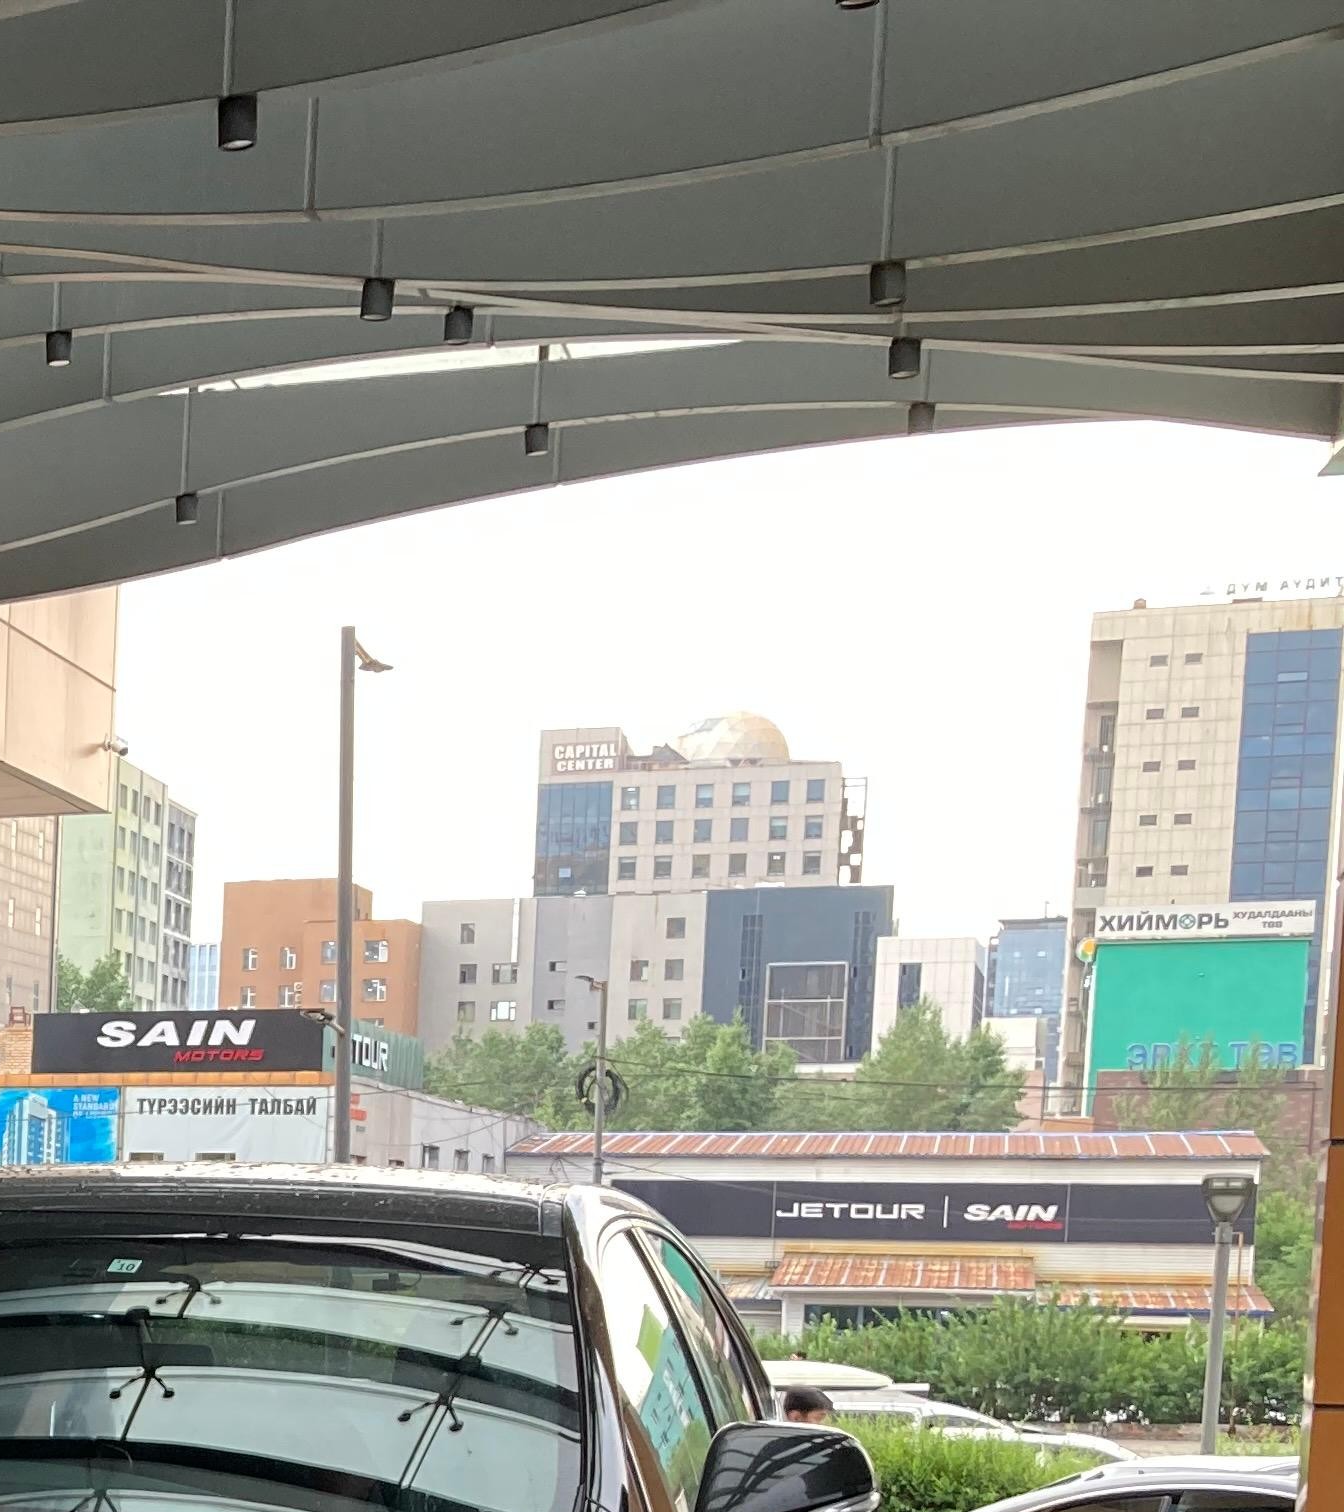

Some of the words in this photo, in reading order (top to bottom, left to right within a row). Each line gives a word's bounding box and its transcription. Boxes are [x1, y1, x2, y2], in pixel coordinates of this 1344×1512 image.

[554, 743, 617, 759] CAPITAL
[556, 758, 614, 772] CENTER
[96, 1018, 258, 1048] SAIN
[173, 1049, 265, 1062] MOTORS
[349, 1033, 389, 1072] TOUR
[136, 1095, 237, 1116] ТҮРЭЭСИЙН
[249, 1095, 317, 1116] ТАЛБАЙ
[776, 1202, 926, 1220] JETOUR
[963, 1203, 1059, 1222] SAIN
